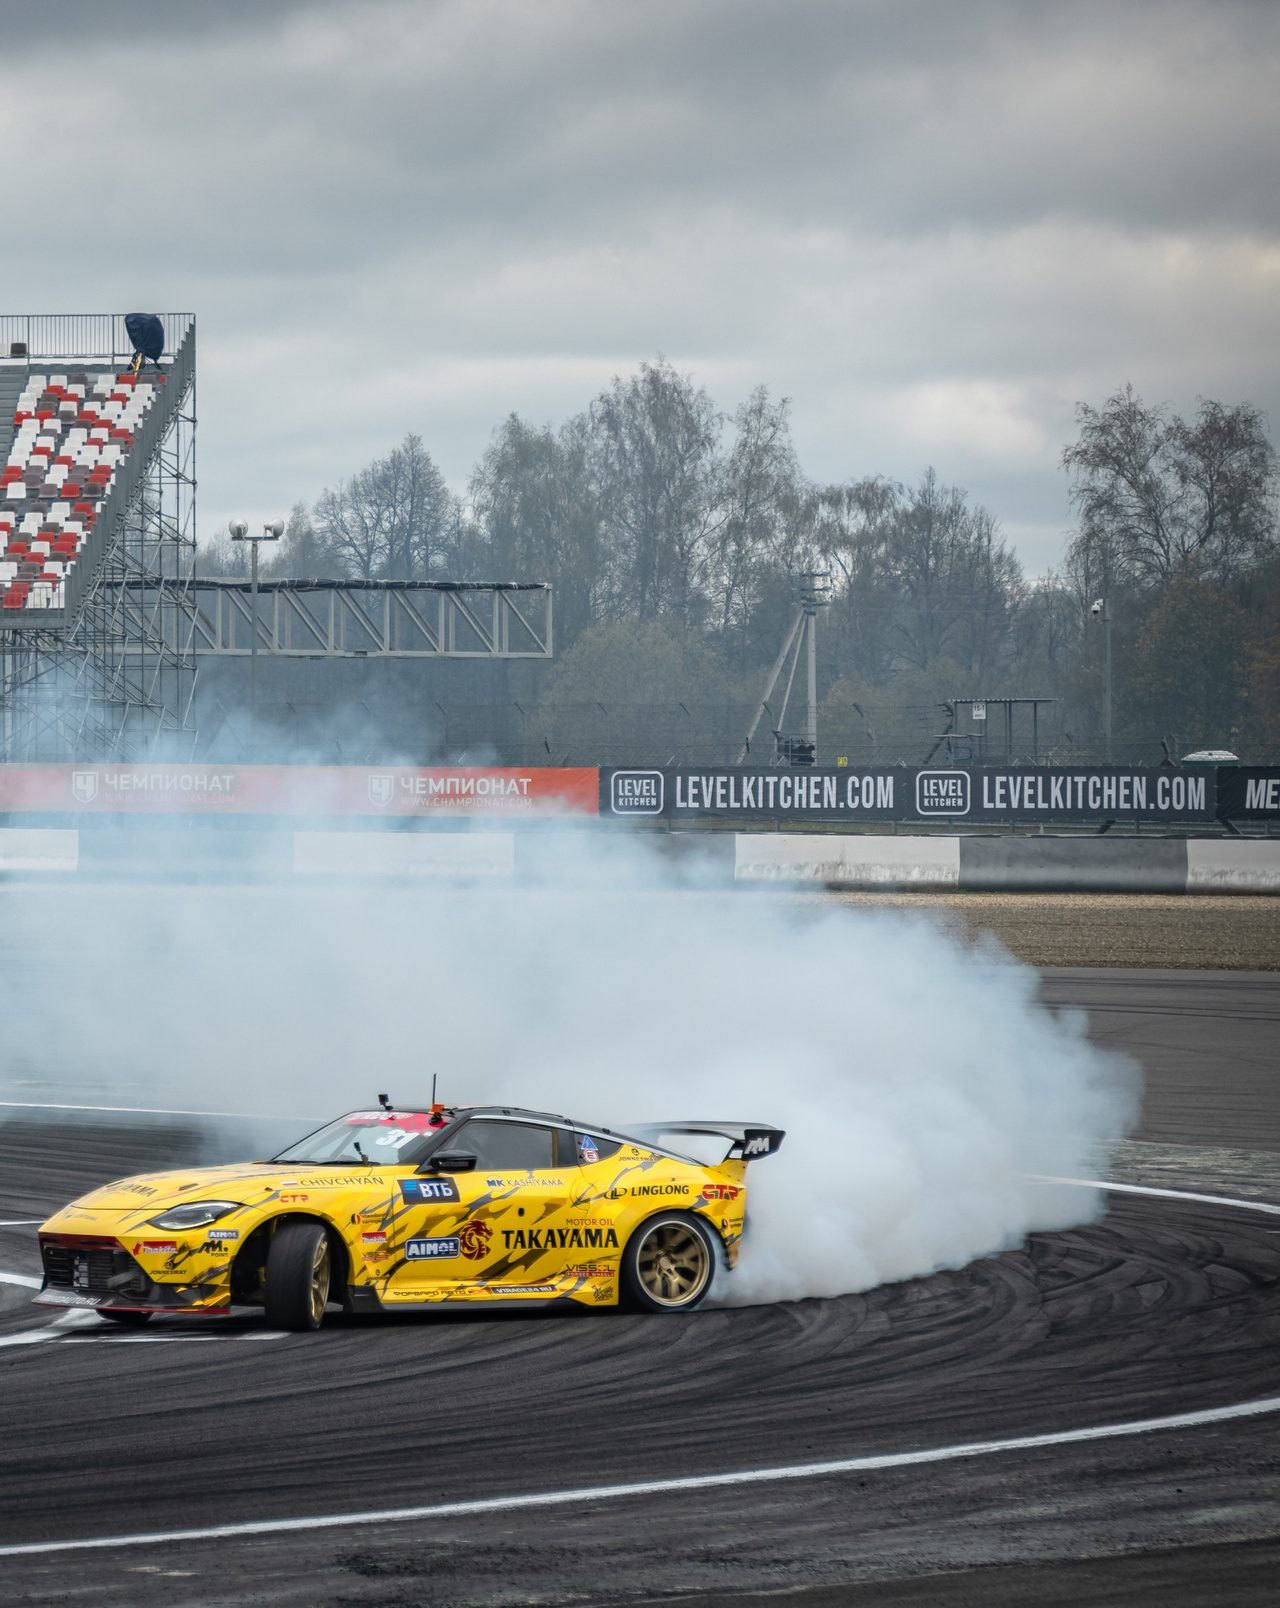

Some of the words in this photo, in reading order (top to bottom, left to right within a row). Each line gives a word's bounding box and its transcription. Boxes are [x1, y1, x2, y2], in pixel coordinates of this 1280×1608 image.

[104, 773, 235, 791] ЧЕМПИОНАТ
[400, 777, 532, 795] ЧЕМПИОНАТ
[618, 779, 657, 796] LEVEL
[923, 779, 963, 796] LEVEL
[675, 775, 894, 809] LEVELKITCHEN.COM
[983, 776, 1206, 810] LEVELKITCHEN.COM
[1245, 779, 1280, 809] ME
[618, 797, 657, 806] KITCHEN
[923, 797, 963, 807] KITCHEN
[375, 1129, 420, 1149] 31
[300, 1176, 384, 1187] CHIVCHYAN
[506, 1178, 564, 1188] KASHIYAMA
[419, 1182, 453, 1198] ВТБ
[631, 1185, 690, 1197] LINGLONG
[566, 1218, 597, 1227] MOTOR
[599, 1218, 615, 1227] OIL
[501, 1228, 620, 1250] TAKAYAMA
[408, 1242, 458, 1256] AIMOL
[566, 1264, 616, 1272] VISSOL
